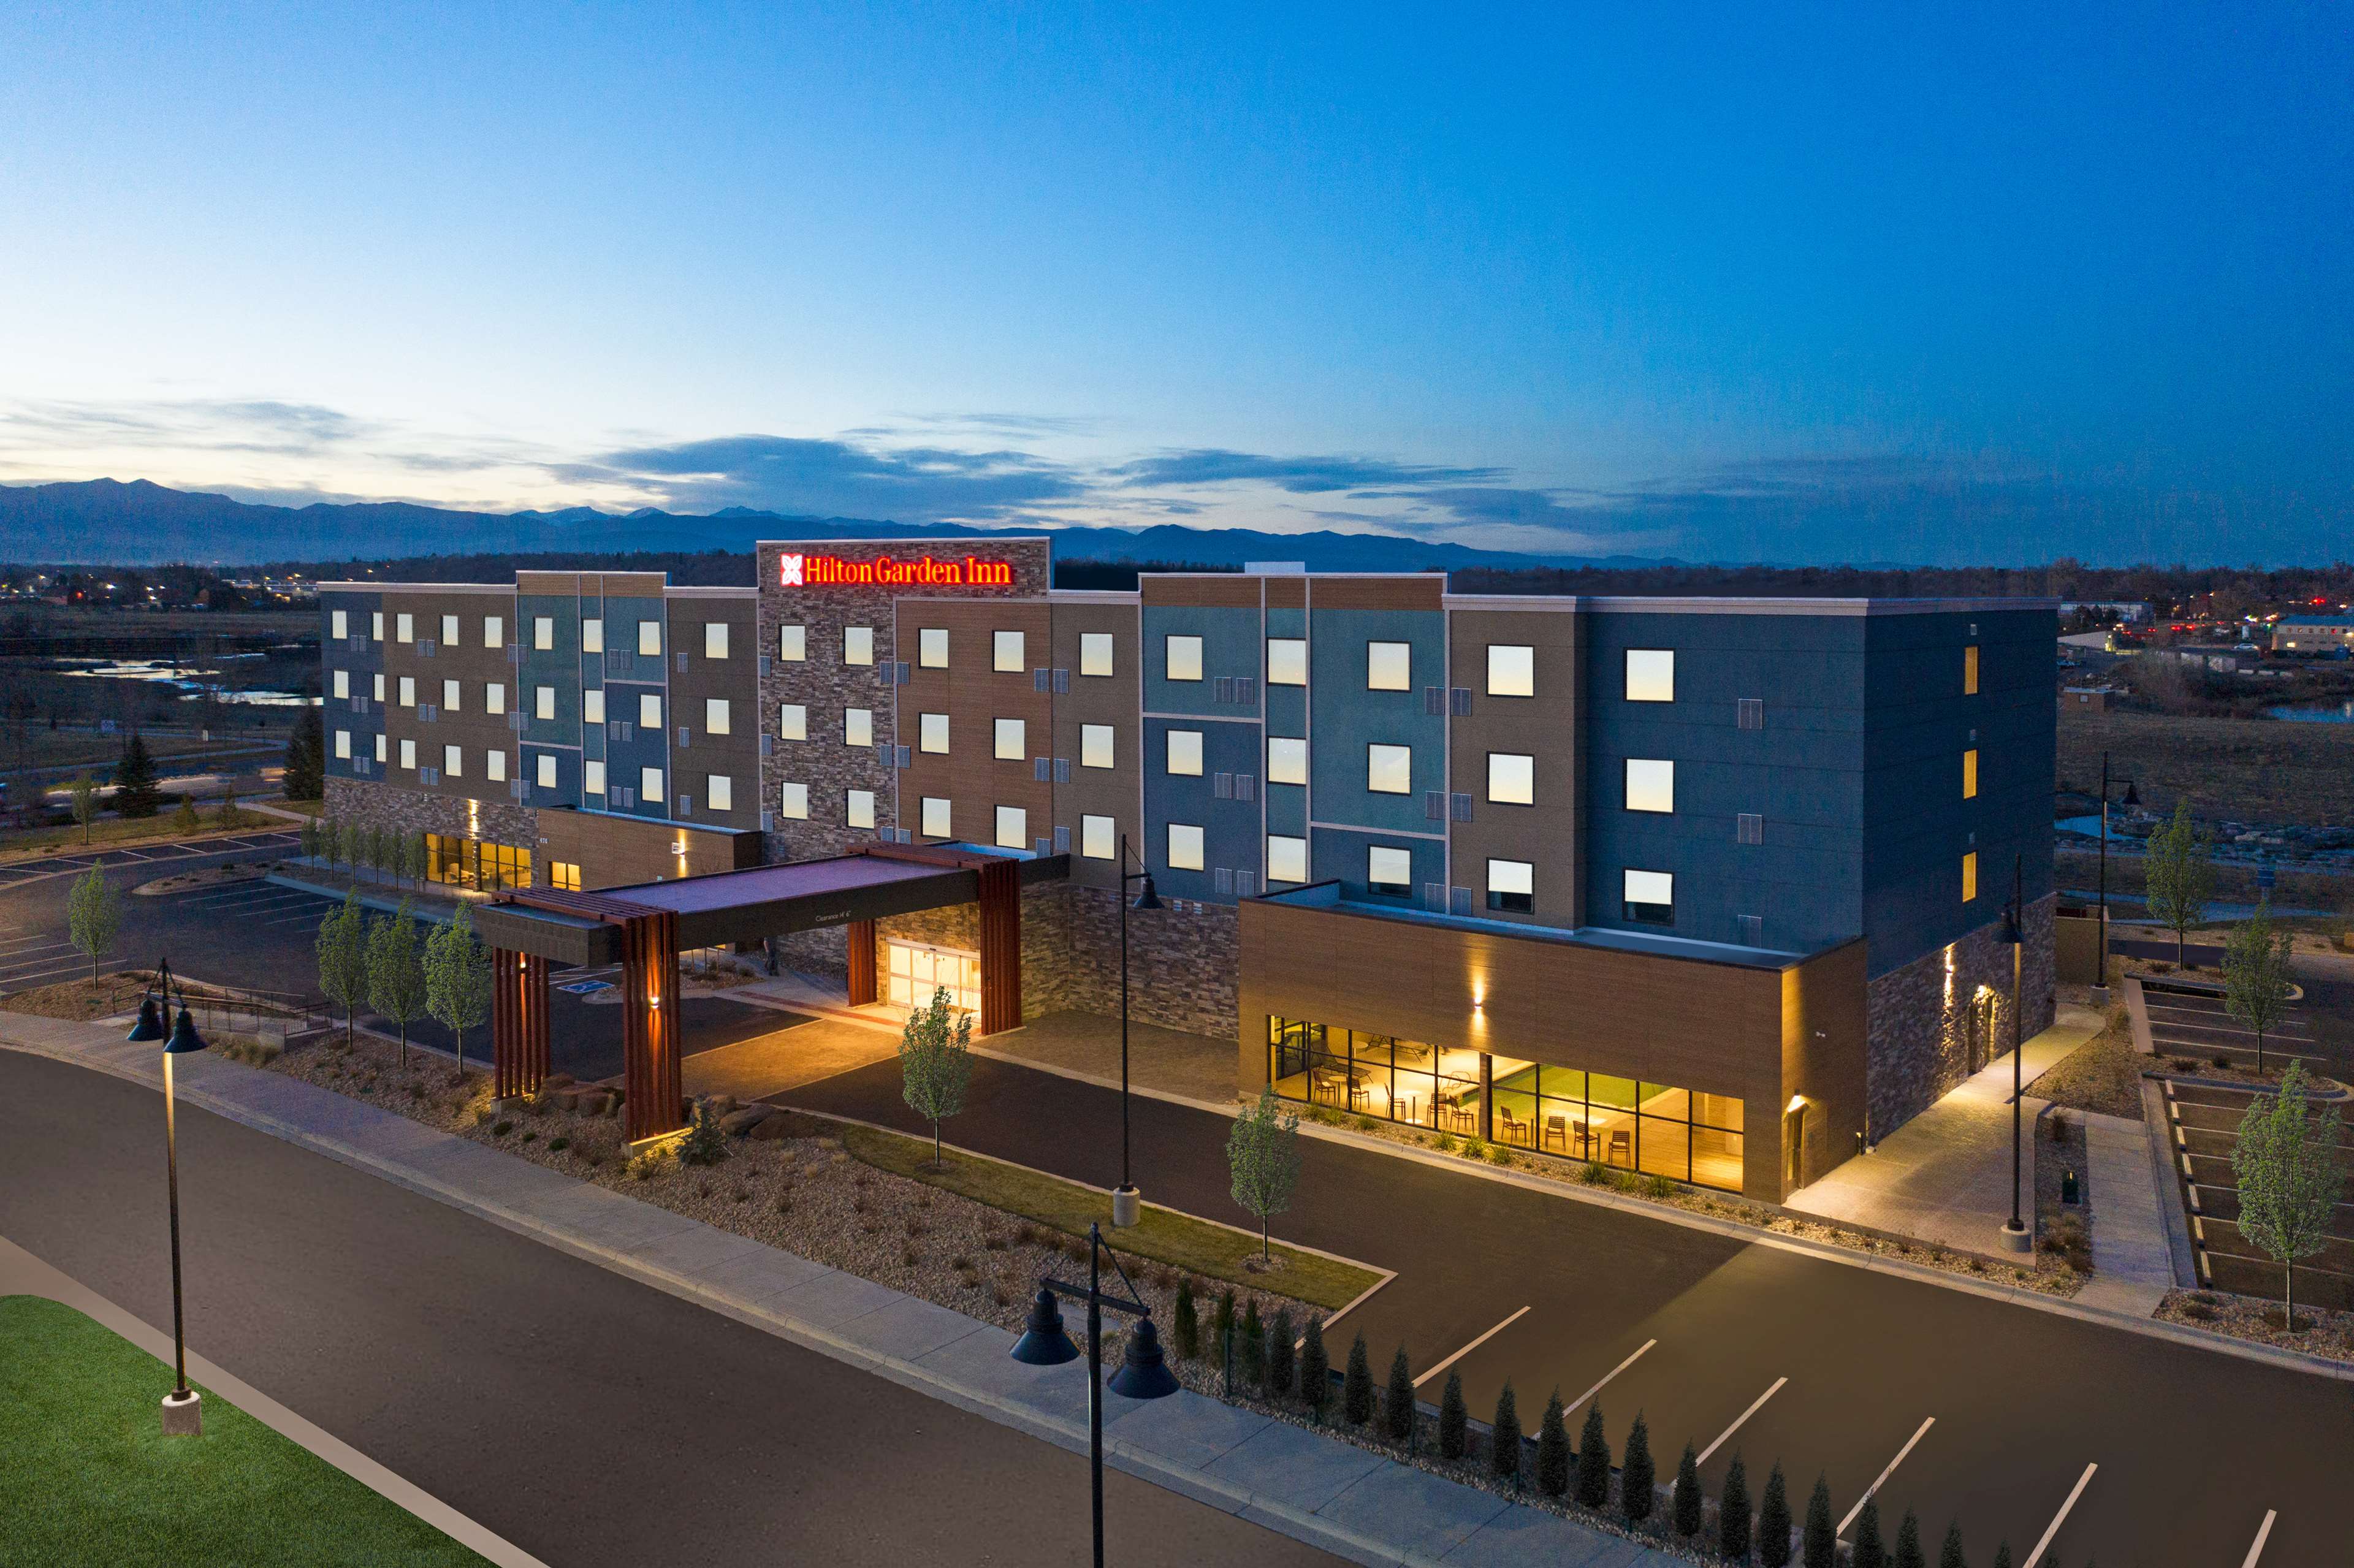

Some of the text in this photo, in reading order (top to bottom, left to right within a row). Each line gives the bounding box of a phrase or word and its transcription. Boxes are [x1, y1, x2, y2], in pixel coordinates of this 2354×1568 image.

[806, 557, 1011, 583] Hilton Garden Inn
